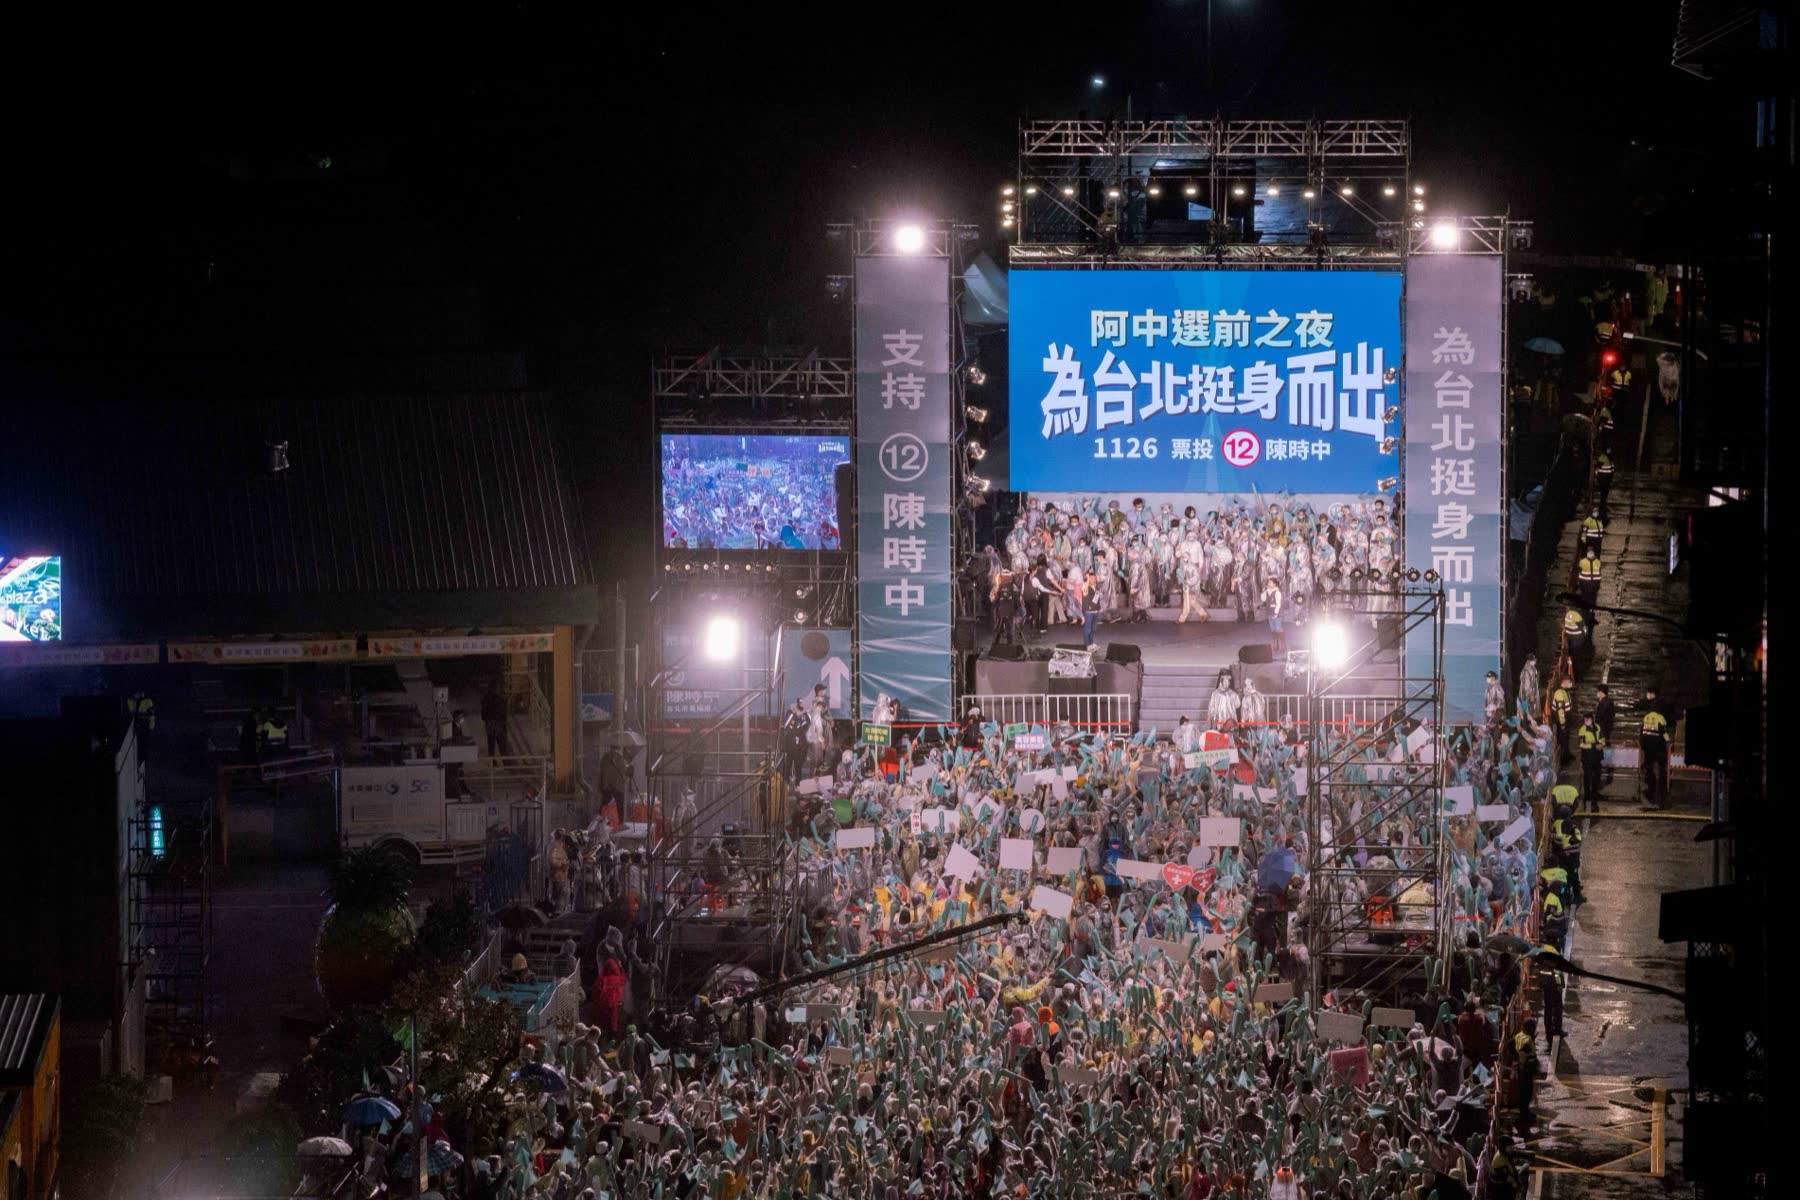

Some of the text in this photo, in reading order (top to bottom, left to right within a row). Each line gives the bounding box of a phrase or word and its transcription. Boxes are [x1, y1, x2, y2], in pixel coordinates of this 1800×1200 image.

[881, 328, 926, 411] 支持
[1090, 309, 1334, 348] 阿中選前之夜
[1040, 341, 1387, 444] 為台北挺身而出
[1093, 437, 1159, 460] 1126
[1171, 438, 1214, 460] 票投
[1265, 438, 1332, 461] 陳時中
[1431, 326, 1476, 627] 為台北挺身而出
[882, 492, 927, 617] 陳時中
